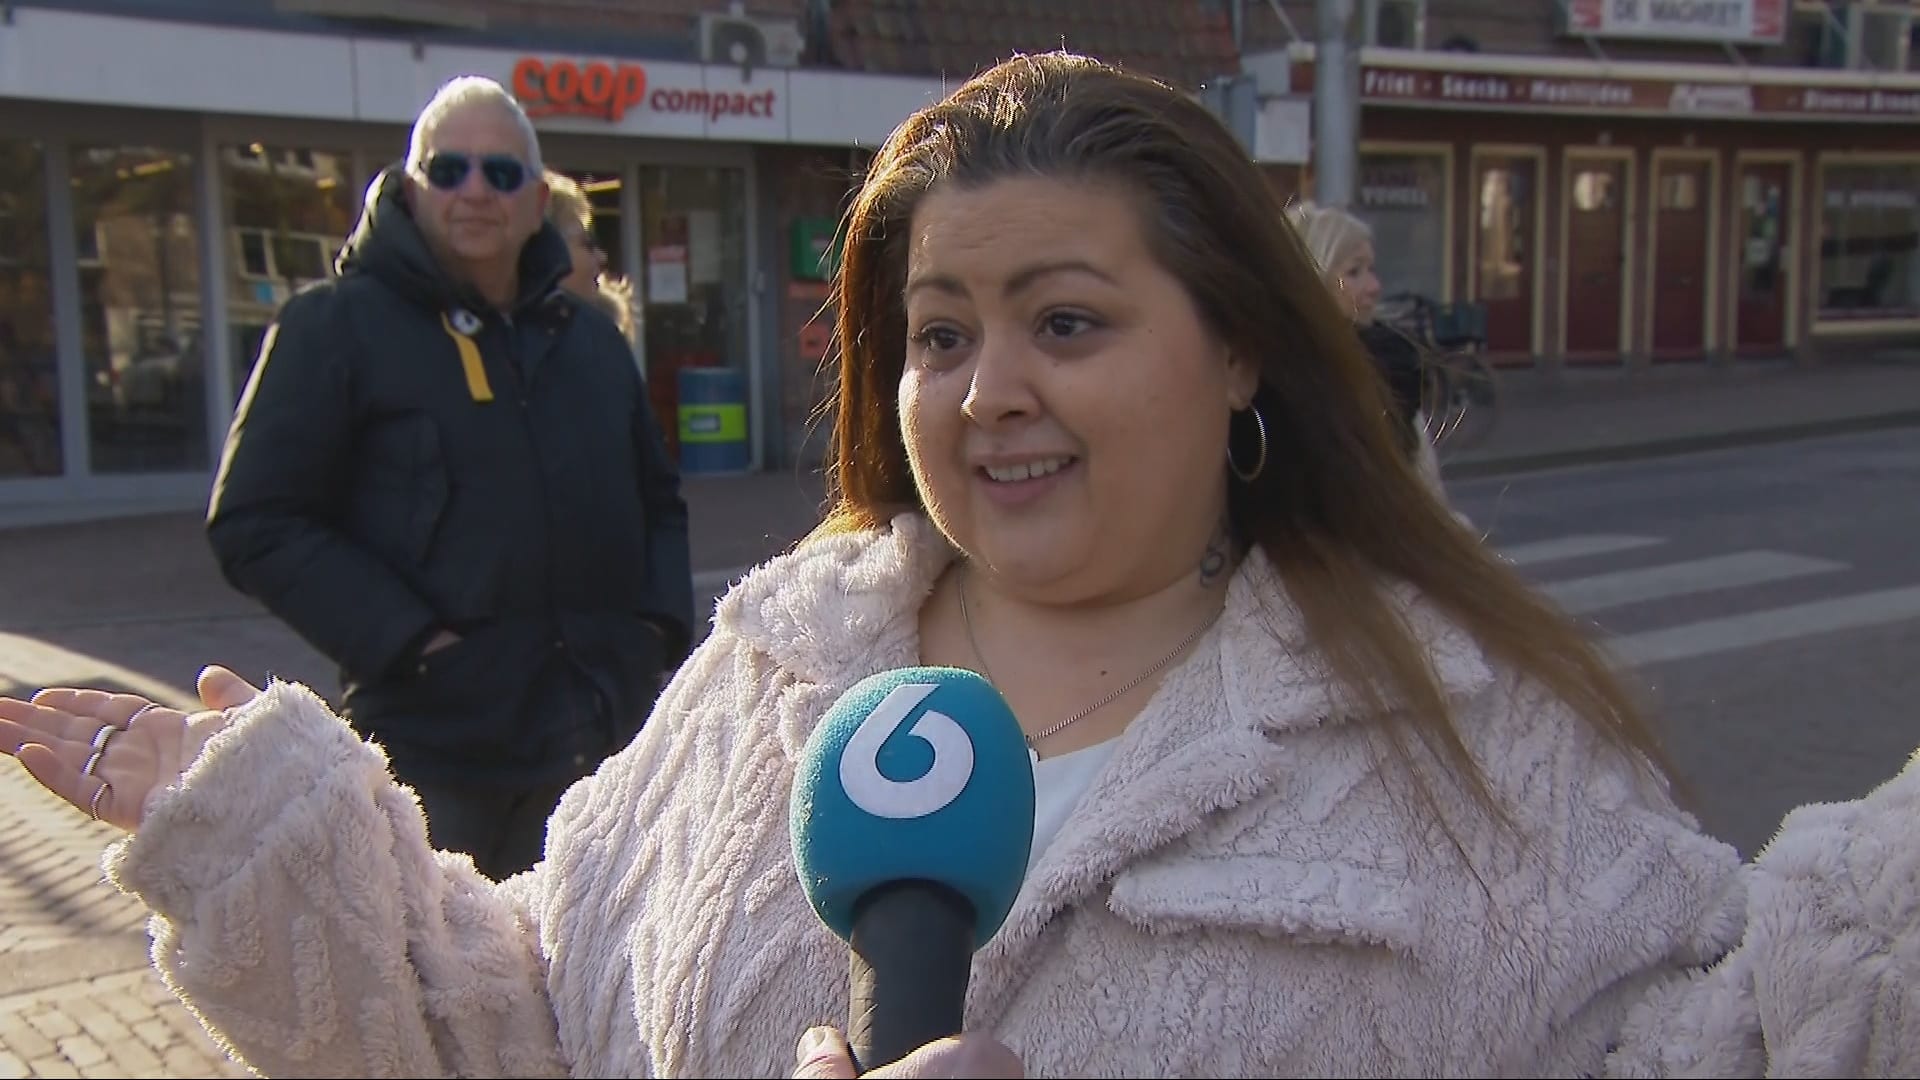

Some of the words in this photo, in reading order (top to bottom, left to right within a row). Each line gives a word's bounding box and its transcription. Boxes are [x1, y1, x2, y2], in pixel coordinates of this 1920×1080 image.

[512, 56, 647, 123] coop
[649, 87, 776, 123] compact
[1364, 70, 1415, 96] Friet
[838, 683, 976, 819] 6
